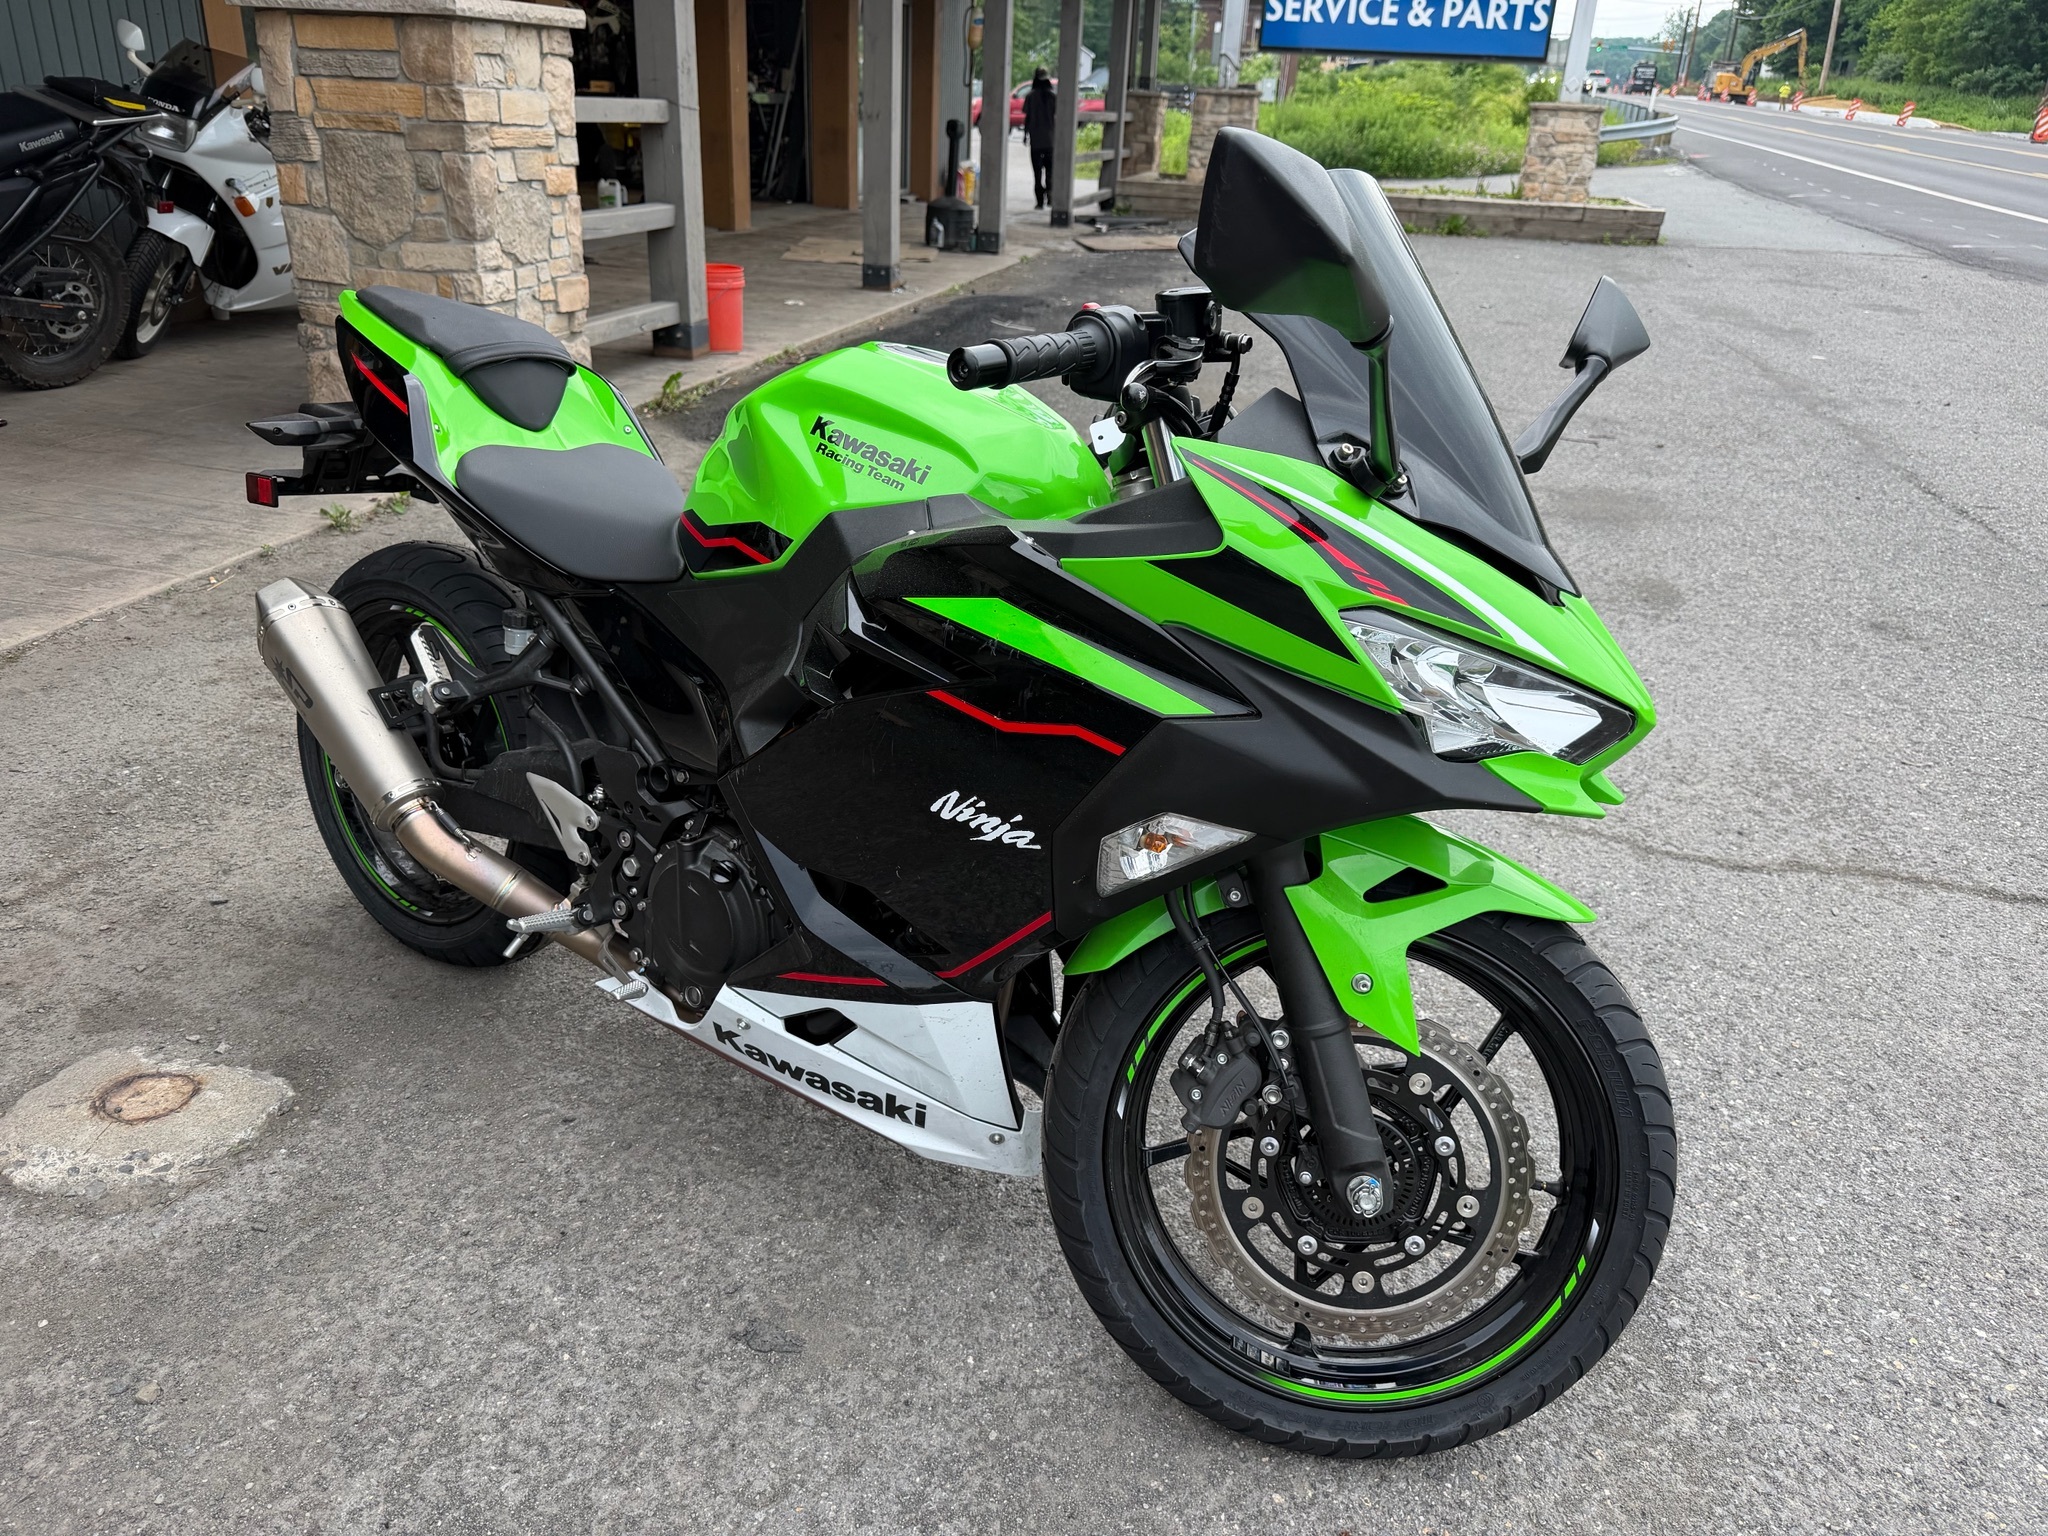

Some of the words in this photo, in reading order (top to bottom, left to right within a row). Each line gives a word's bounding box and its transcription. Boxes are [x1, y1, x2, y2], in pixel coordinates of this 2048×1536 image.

[1265, 0, 1399, 26] SERVICE
[1408, 0, 1434, 28] &
[1442, 0, 1550, 32] PARTS
[18, 129, 65, 153] Kawasaki
[810, 415, 933, 485] Kawasaki
[815, 442, 865, 474] Racing
[867, 465, 906, 491] Team
[930, 790, 1042, 850] Ninja
[712, 1021, 927, 1129] Kawasaki
